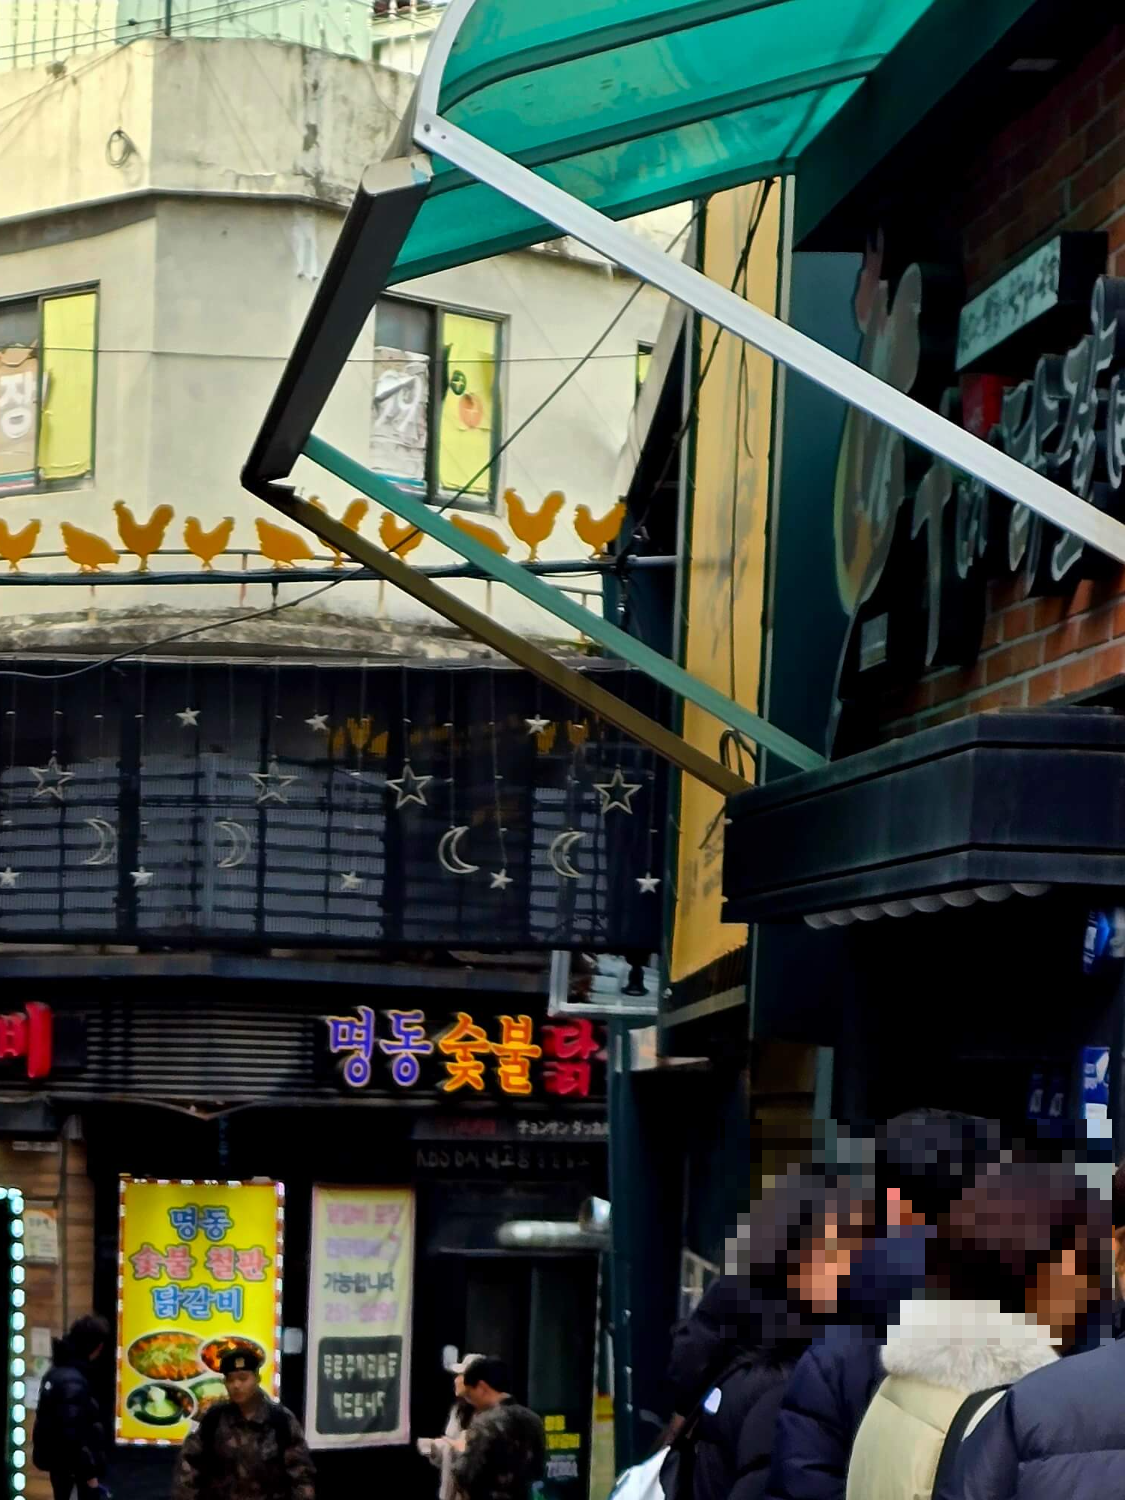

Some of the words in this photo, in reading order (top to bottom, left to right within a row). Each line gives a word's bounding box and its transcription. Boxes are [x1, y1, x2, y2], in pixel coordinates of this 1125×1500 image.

[169, 1203, 233, 1241] 명동
[129, 1243, 196, 1280] 숯불
[205, 1244, 271, 1282] 철판
[151, 1282, 243, 1321] 닭갈비
